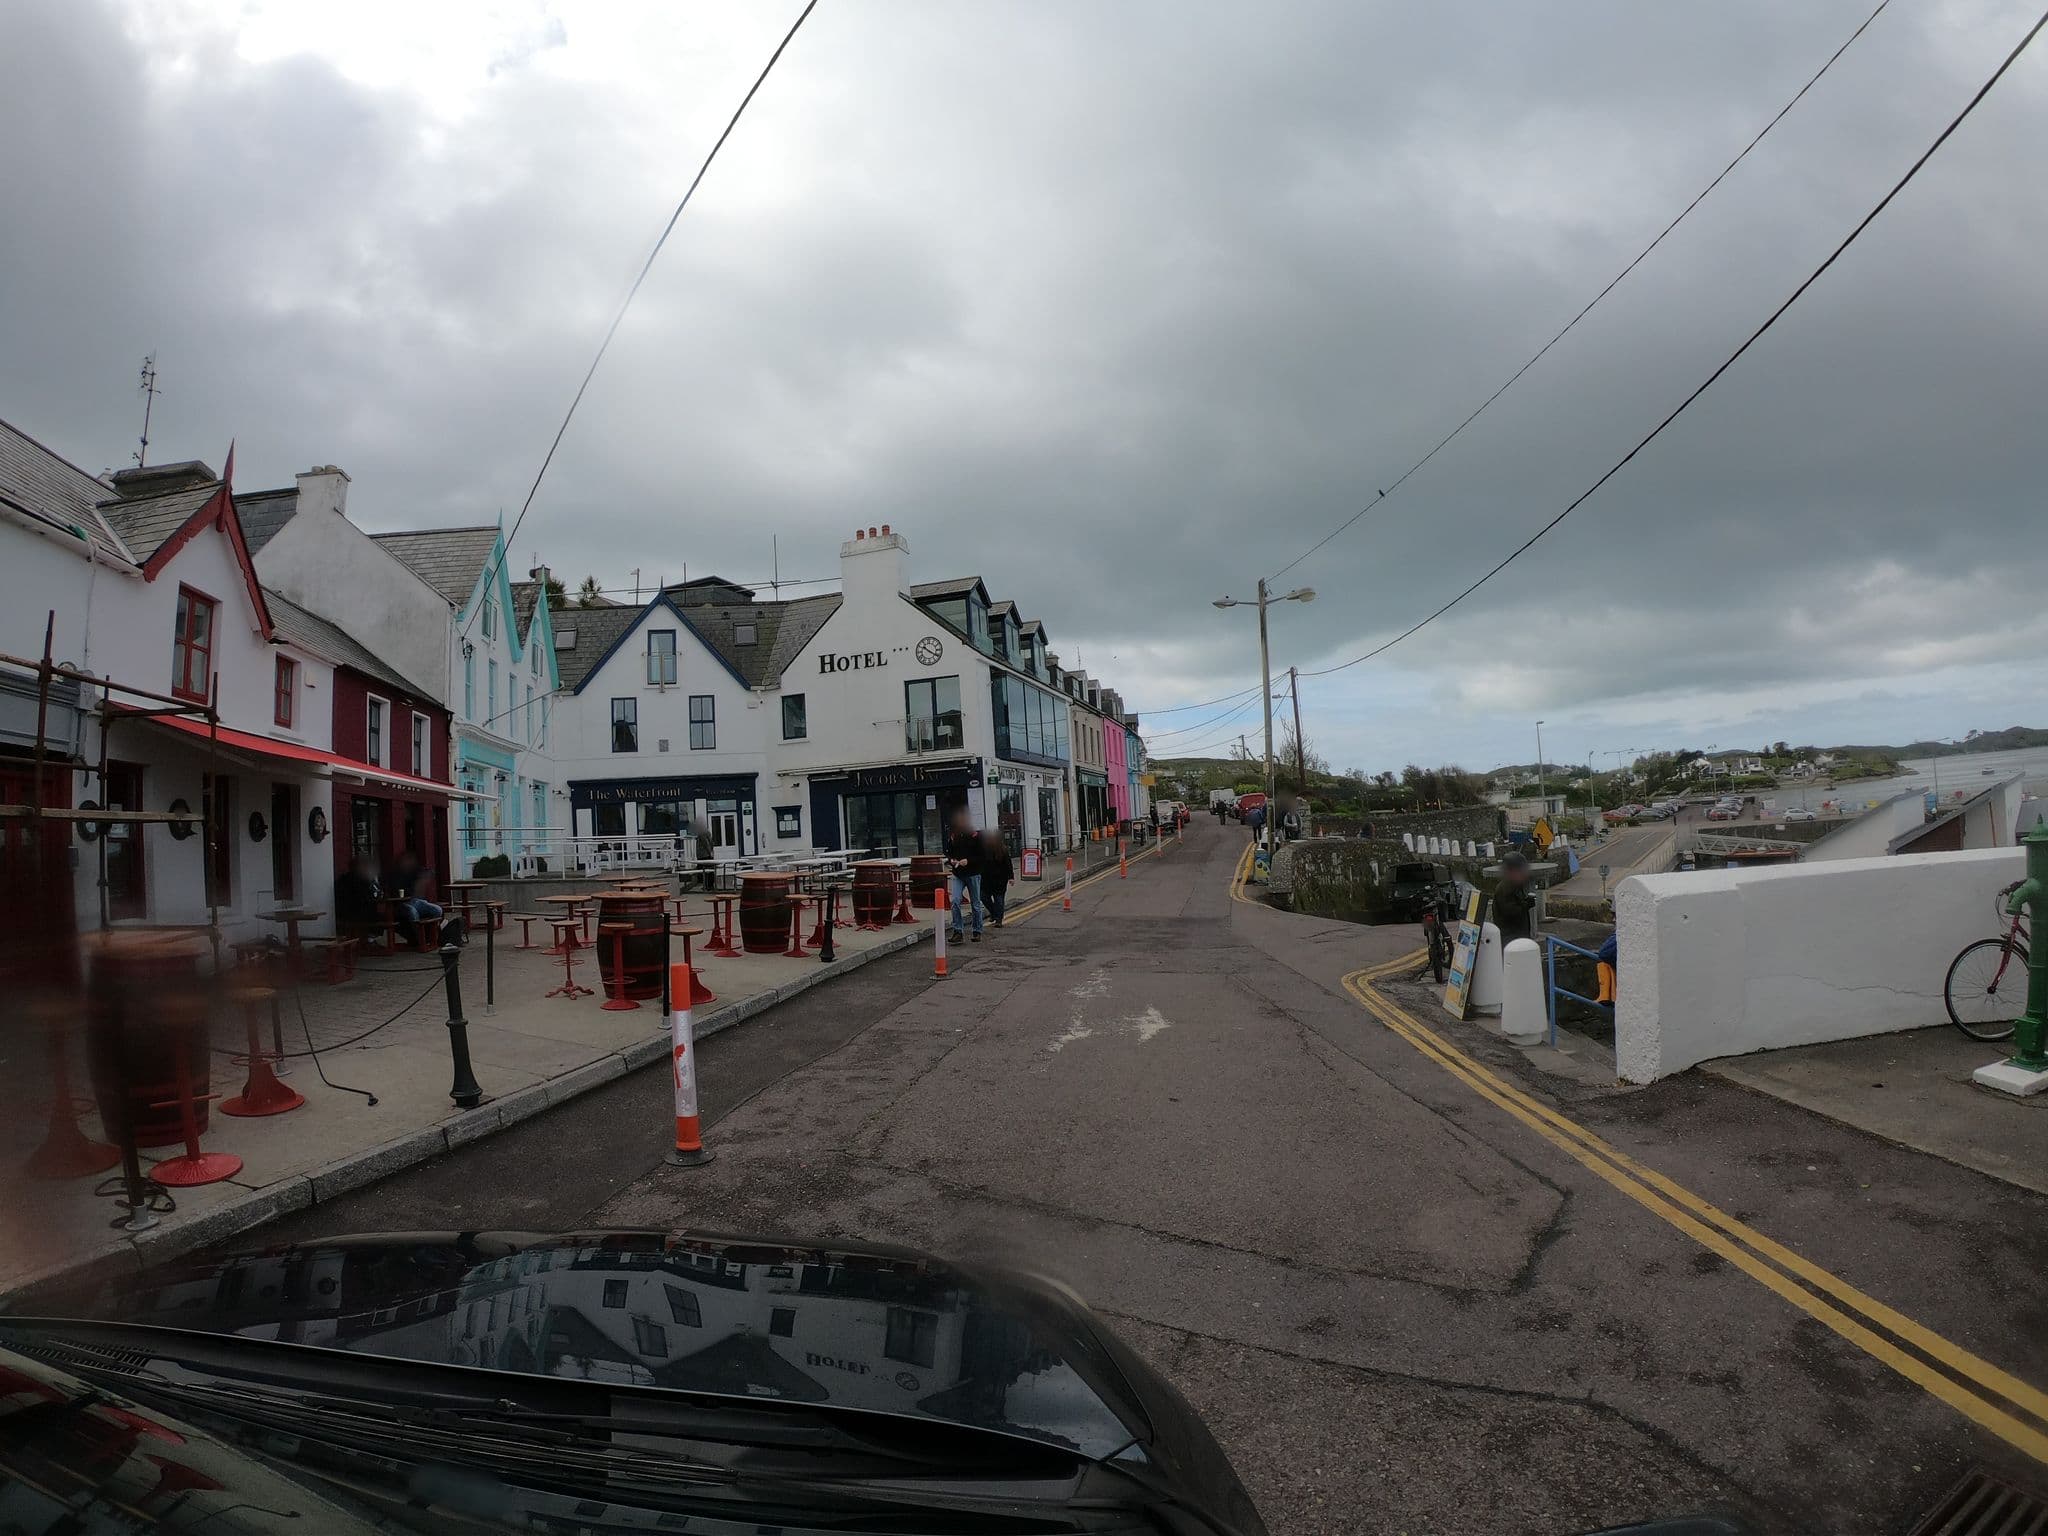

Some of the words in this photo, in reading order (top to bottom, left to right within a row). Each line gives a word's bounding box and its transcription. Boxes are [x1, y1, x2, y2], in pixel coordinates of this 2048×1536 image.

[818, 651, 888, 674] HOTEL
[588, 789, 610, 801] The
[615, 787, 682, 799] Waterfront
